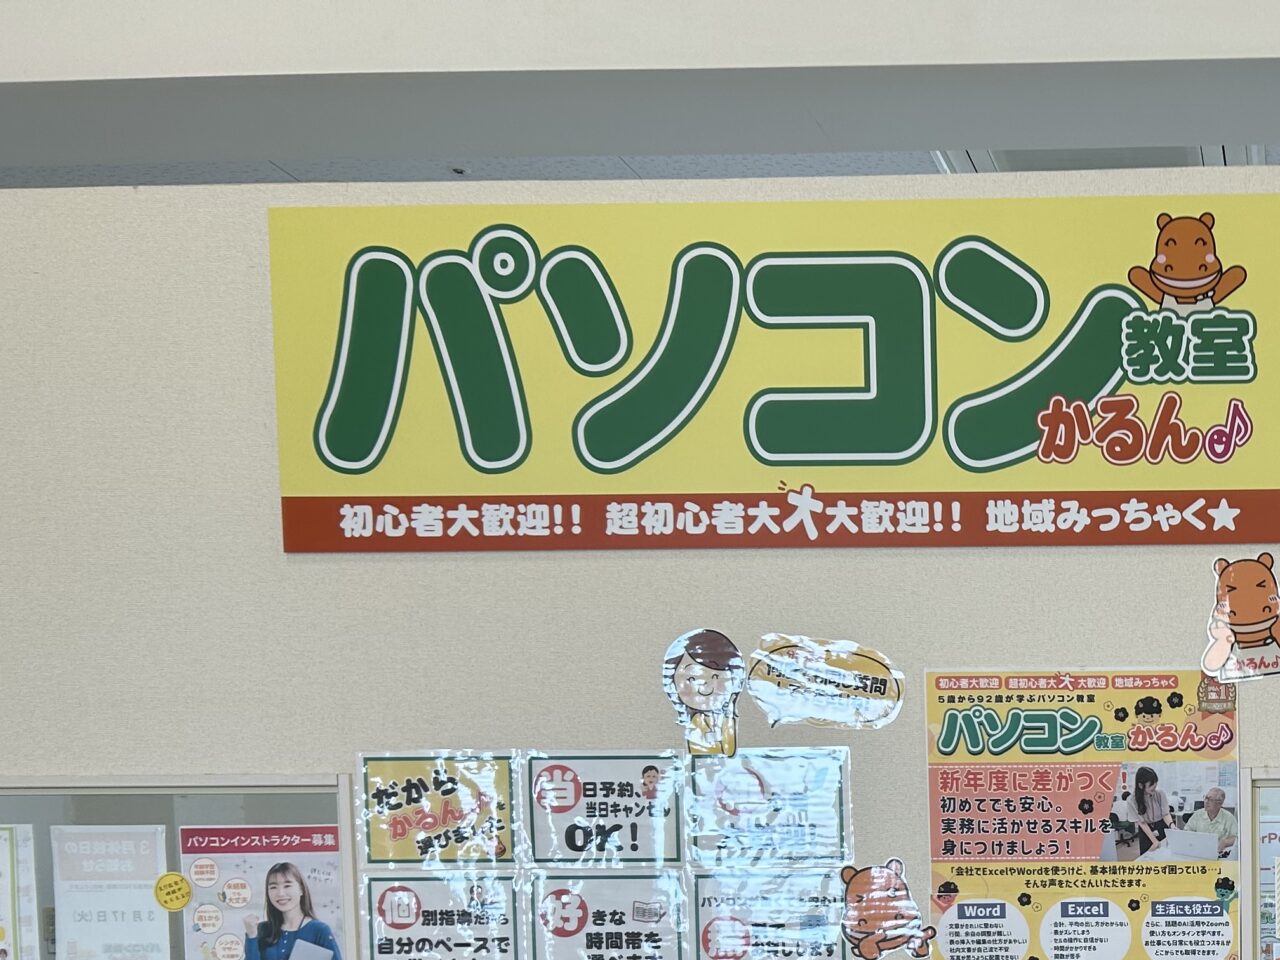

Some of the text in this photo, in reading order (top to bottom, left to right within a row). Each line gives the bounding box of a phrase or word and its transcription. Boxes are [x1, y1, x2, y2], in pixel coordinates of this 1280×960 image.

[314, 222, 1257, 475] パソコン 教室 かるん
[339, 500, 582, 540] 初心者大歓迎!!
[938, 677, 1000, 689] 初心者大歓迎
[1114, 676, 1177, 688] 地域みっちゃく
[938, 705, 1204, 755] パソコン 教室 かるん
[938, 769, 1129, 793] 新年度に差がつく！
[371, 768, 459, 815] だから
[939, 796, 1064, 813] 初めてでも安心。
[940, 817, 1112, 834] 実務に活かせるスキルを
[187, 833, 336, 848] パソコンインストラクター募集
[941, 839, 1072, 856] 身につけましょう！
[1023, 878, 1148, 889] そんな声をたくさんいただきます。
[964, 905, 1001, 917] Word
[1068, 903, 1105, 916] Excel
[1155, 903, 1222, 915] 生活にも役立つ
[377, 936, 511, 955] 自分のペースで
[585, 931, 663, 951] 時間帯を
